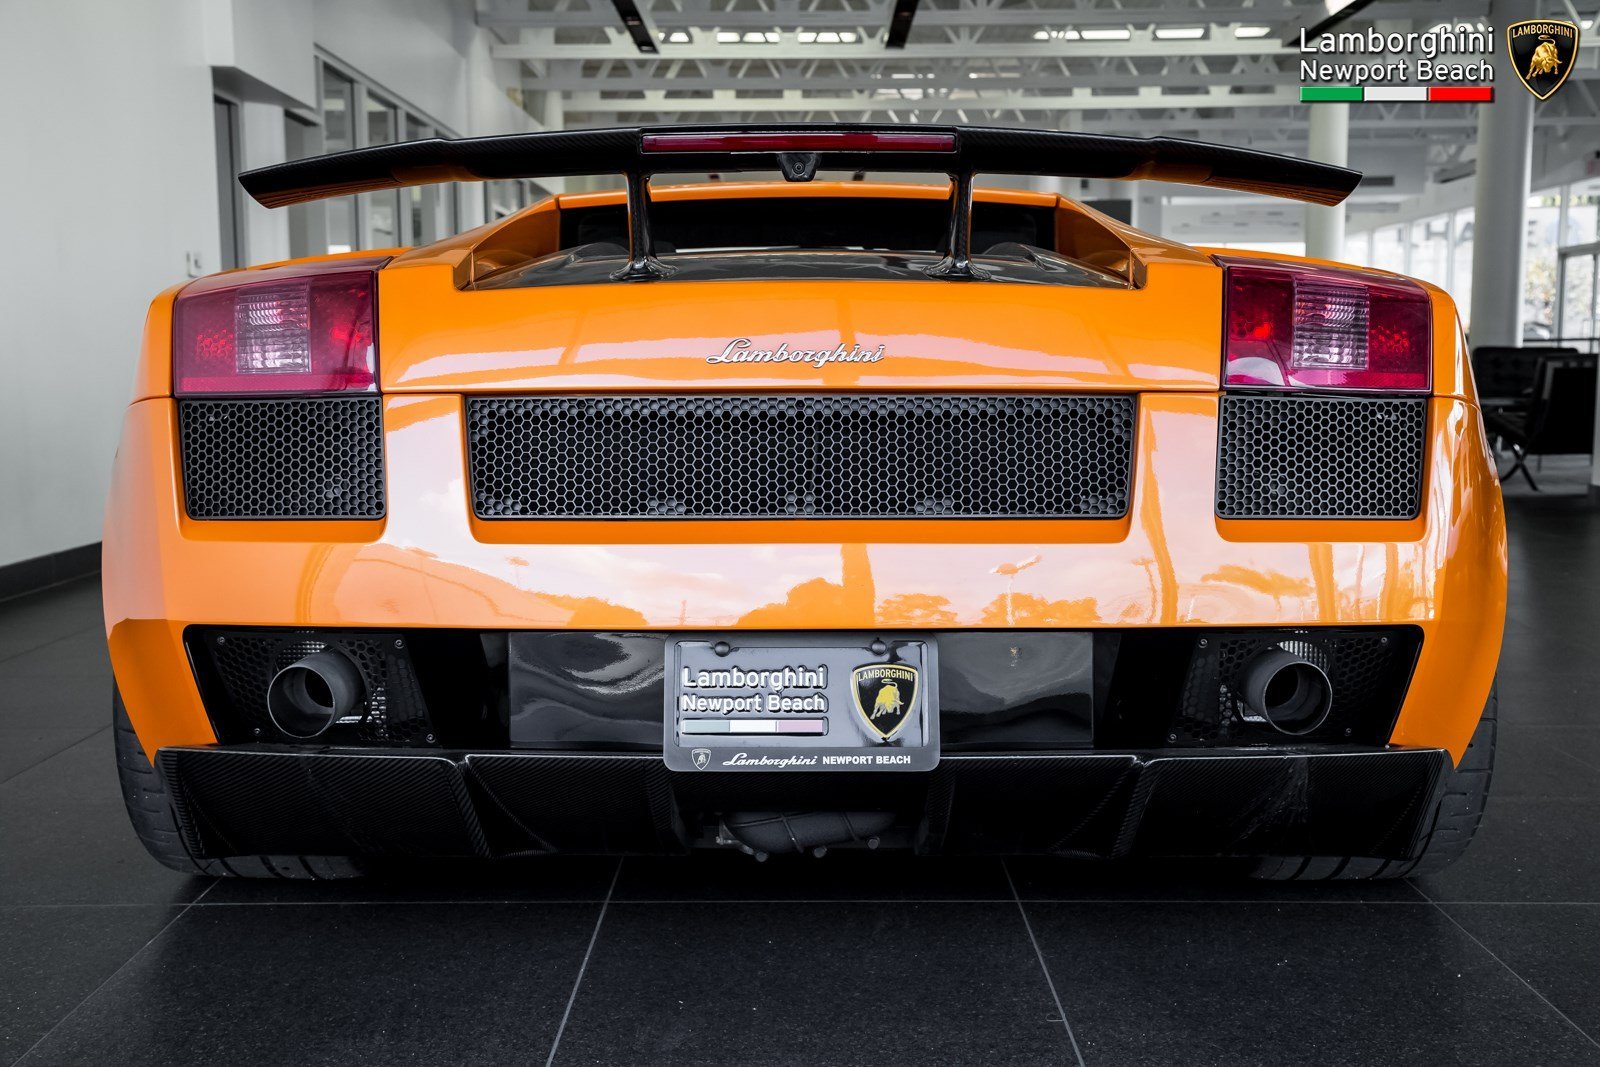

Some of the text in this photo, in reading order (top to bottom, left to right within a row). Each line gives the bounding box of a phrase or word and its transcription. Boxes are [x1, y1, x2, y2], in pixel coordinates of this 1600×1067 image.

[706, 338, 885, 368] Lamborghini
[682, 666, 825, 692] Lamborghini
[858, 669, 914, 682] LAMBORGHINI
[681, 694, 826, 714] Newport Beach
[723, 752, 911, 768] Lamborghini NEWPORT BEACH
